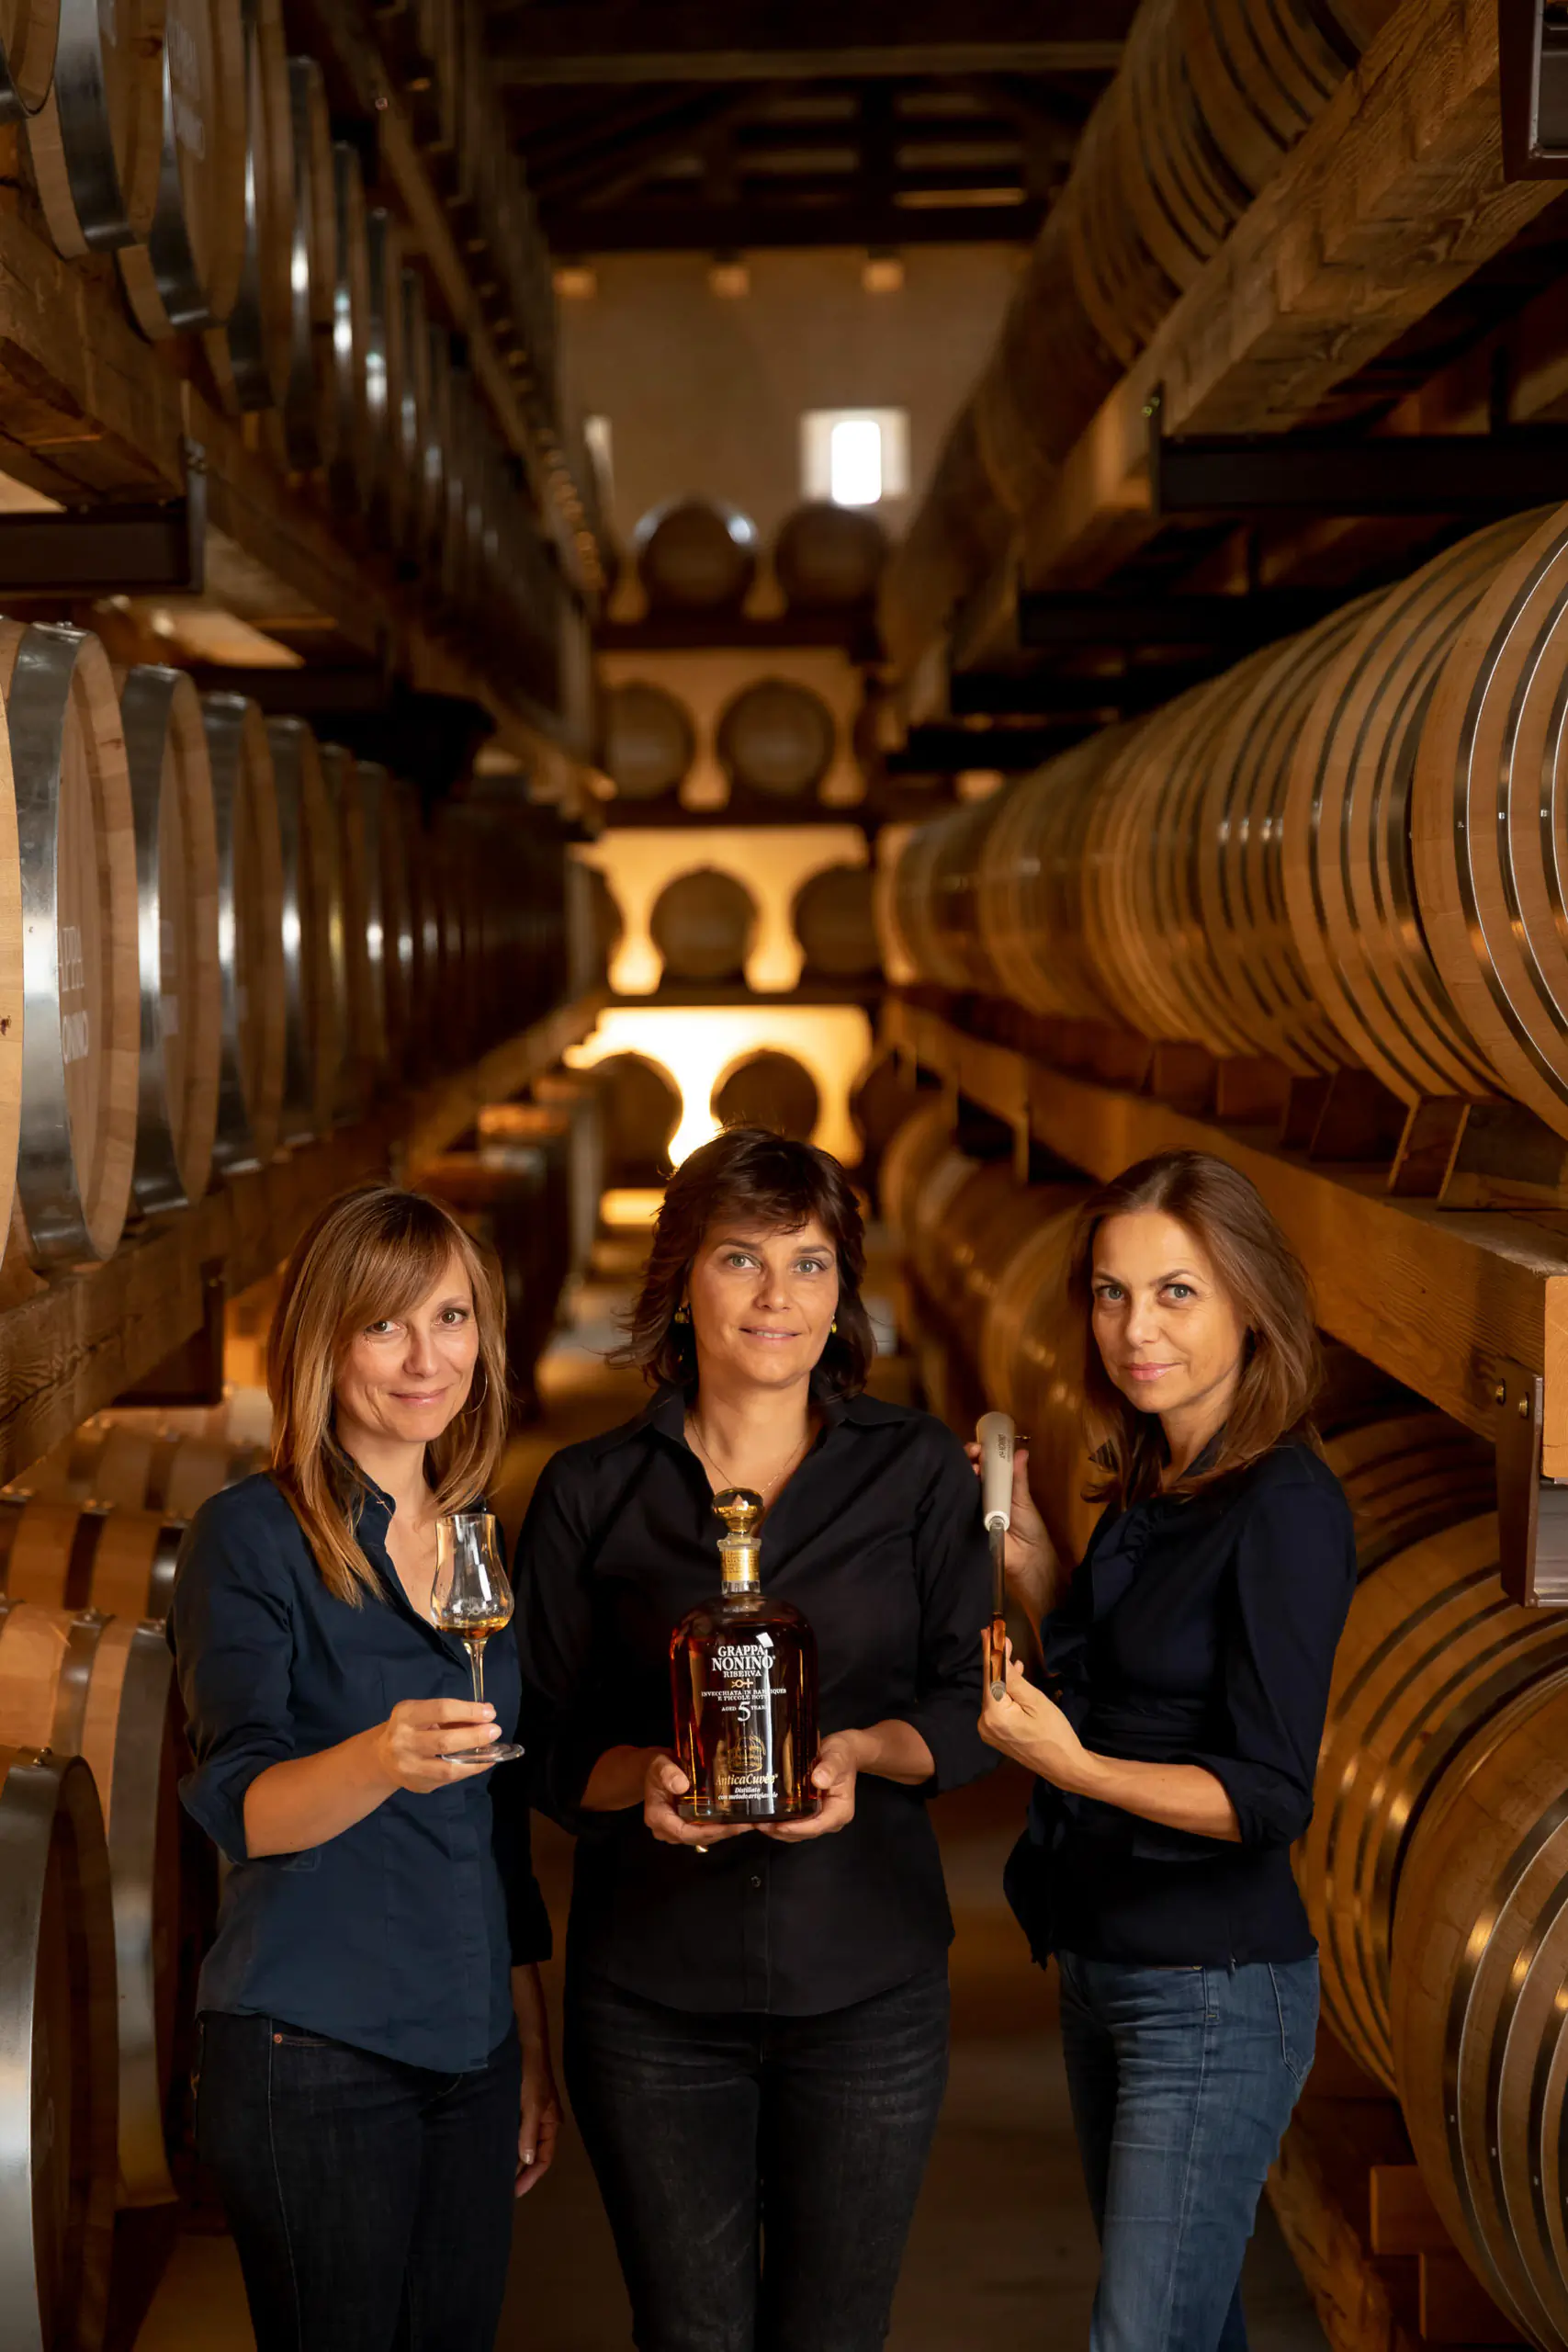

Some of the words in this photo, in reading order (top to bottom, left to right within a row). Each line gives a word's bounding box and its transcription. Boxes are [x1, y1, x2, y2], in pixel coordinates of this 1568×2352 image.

[717, 1645, 764, 1657] GRAPPA
[711, 1656, 773, 1671] NONINO
[723, 1670, 762, 1679] RISERVA
[753, 1688, 786, 1696] BARIQUES
[738, 1701, 751, 1722] 5
